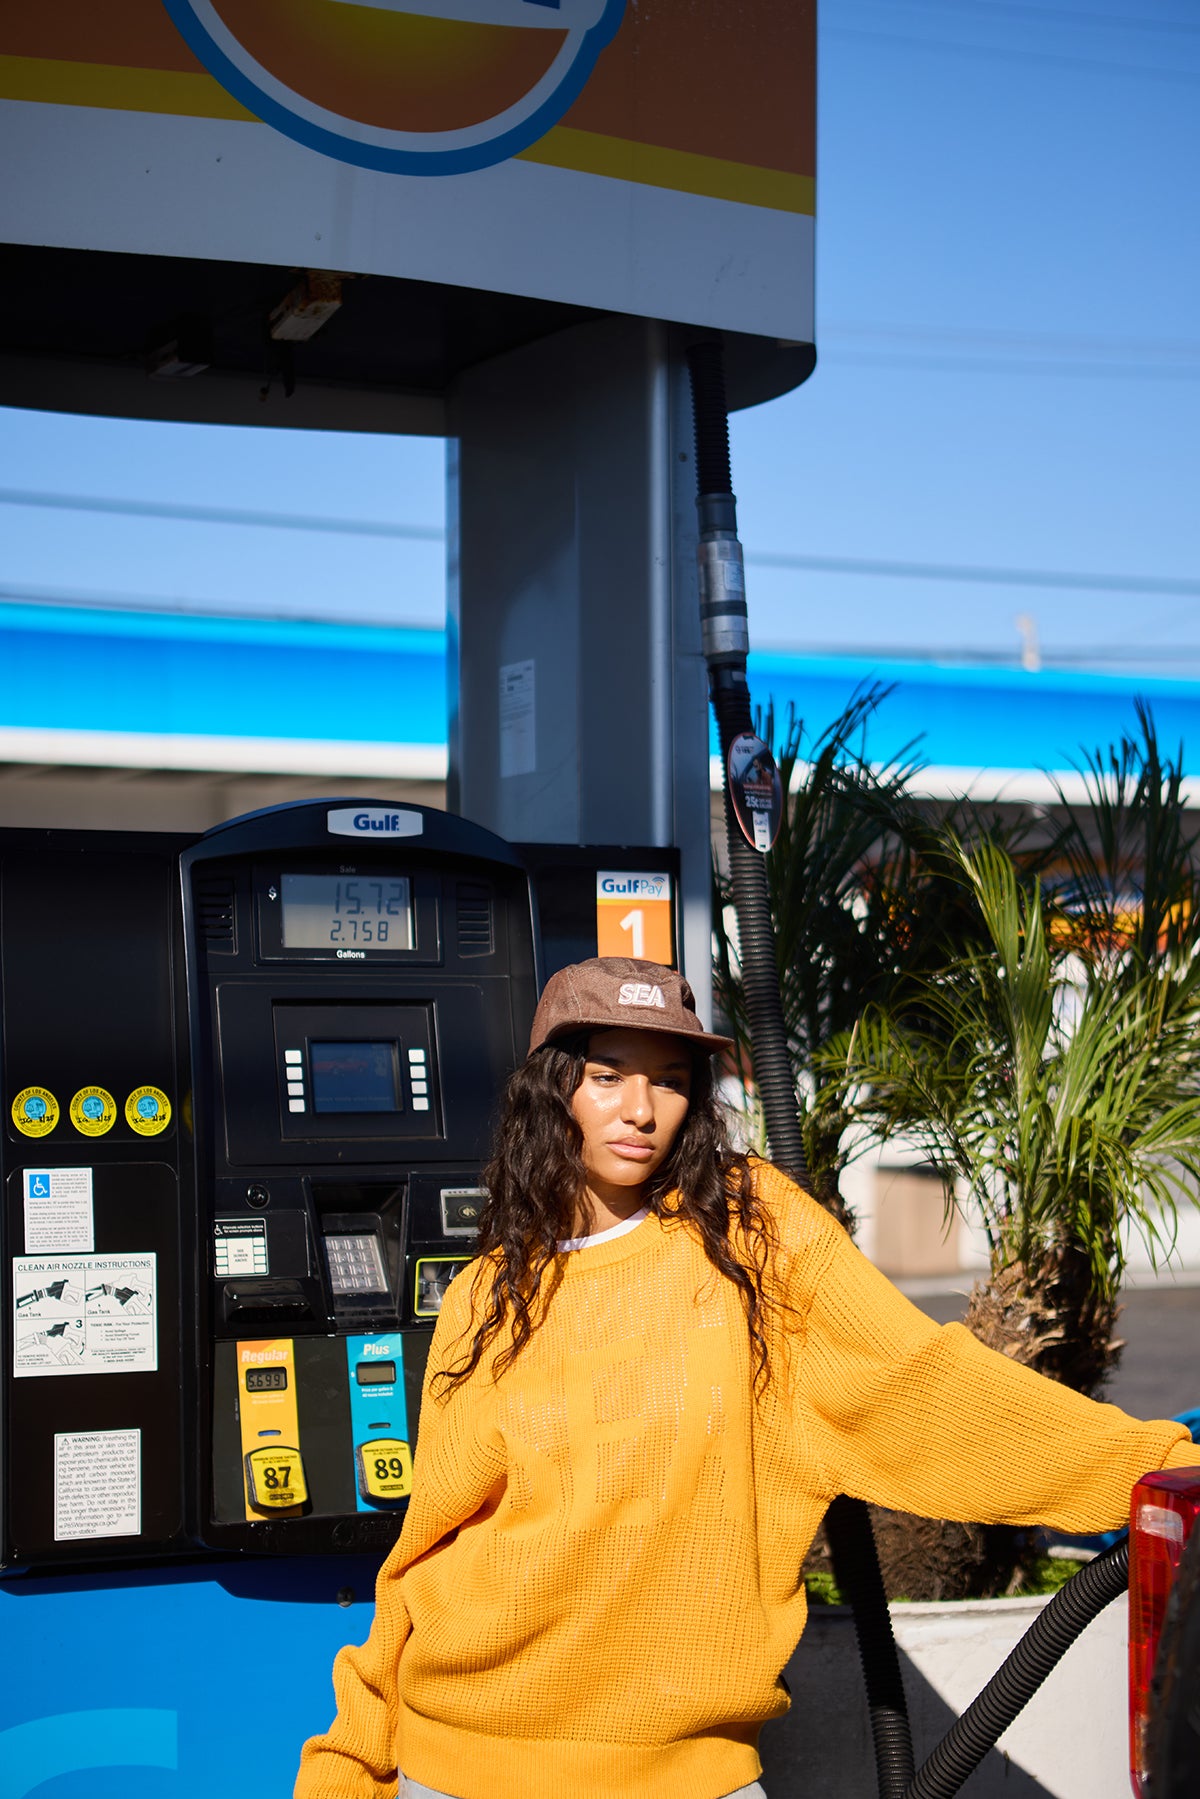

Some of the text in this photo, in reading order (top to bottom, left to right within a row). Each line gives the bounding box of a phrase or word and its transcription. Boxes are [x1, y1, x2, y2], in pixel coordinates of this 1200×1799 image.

[353, 813, 399, 831] Gulf
[268, 886, 277, 900] $
[601, 878, 662, 897] GulfPay
[335, 882, 402, 915] 15.72
[330, 920, 389, 942] 2.758
[619, 909, 644, 958] 1
[336, 949, 365, 959] Gallons
[618, 983, 665, 1008] SEA
[14, 1093, 24, 1111] COUNTY
[43, 1091, 57, 1109] ANGELES
[72, 1093, 82, 1110] COUNTY
[100, 1090, 114, 1108] ANGELES
[127, 1093, 136, 1111] COUNTY
[154, 1090, 168, 1106] ANGELES
[18, 1264, 45, 1272] CLEAN
[62, 1262, 92, 1270] NOZZLE
[95, 1260, 151, 1269] INSTRUCTIONS
[76, 1320, 82, 1328] 3
[241, 1349, 288, 1364] Regular
[363, 1343, 390, 1356] Plus
[248, 1374, 281, 1388] 5.699
[263, 1466, 291, 1489] 87
[374, 1458, 403, 1480] 89
